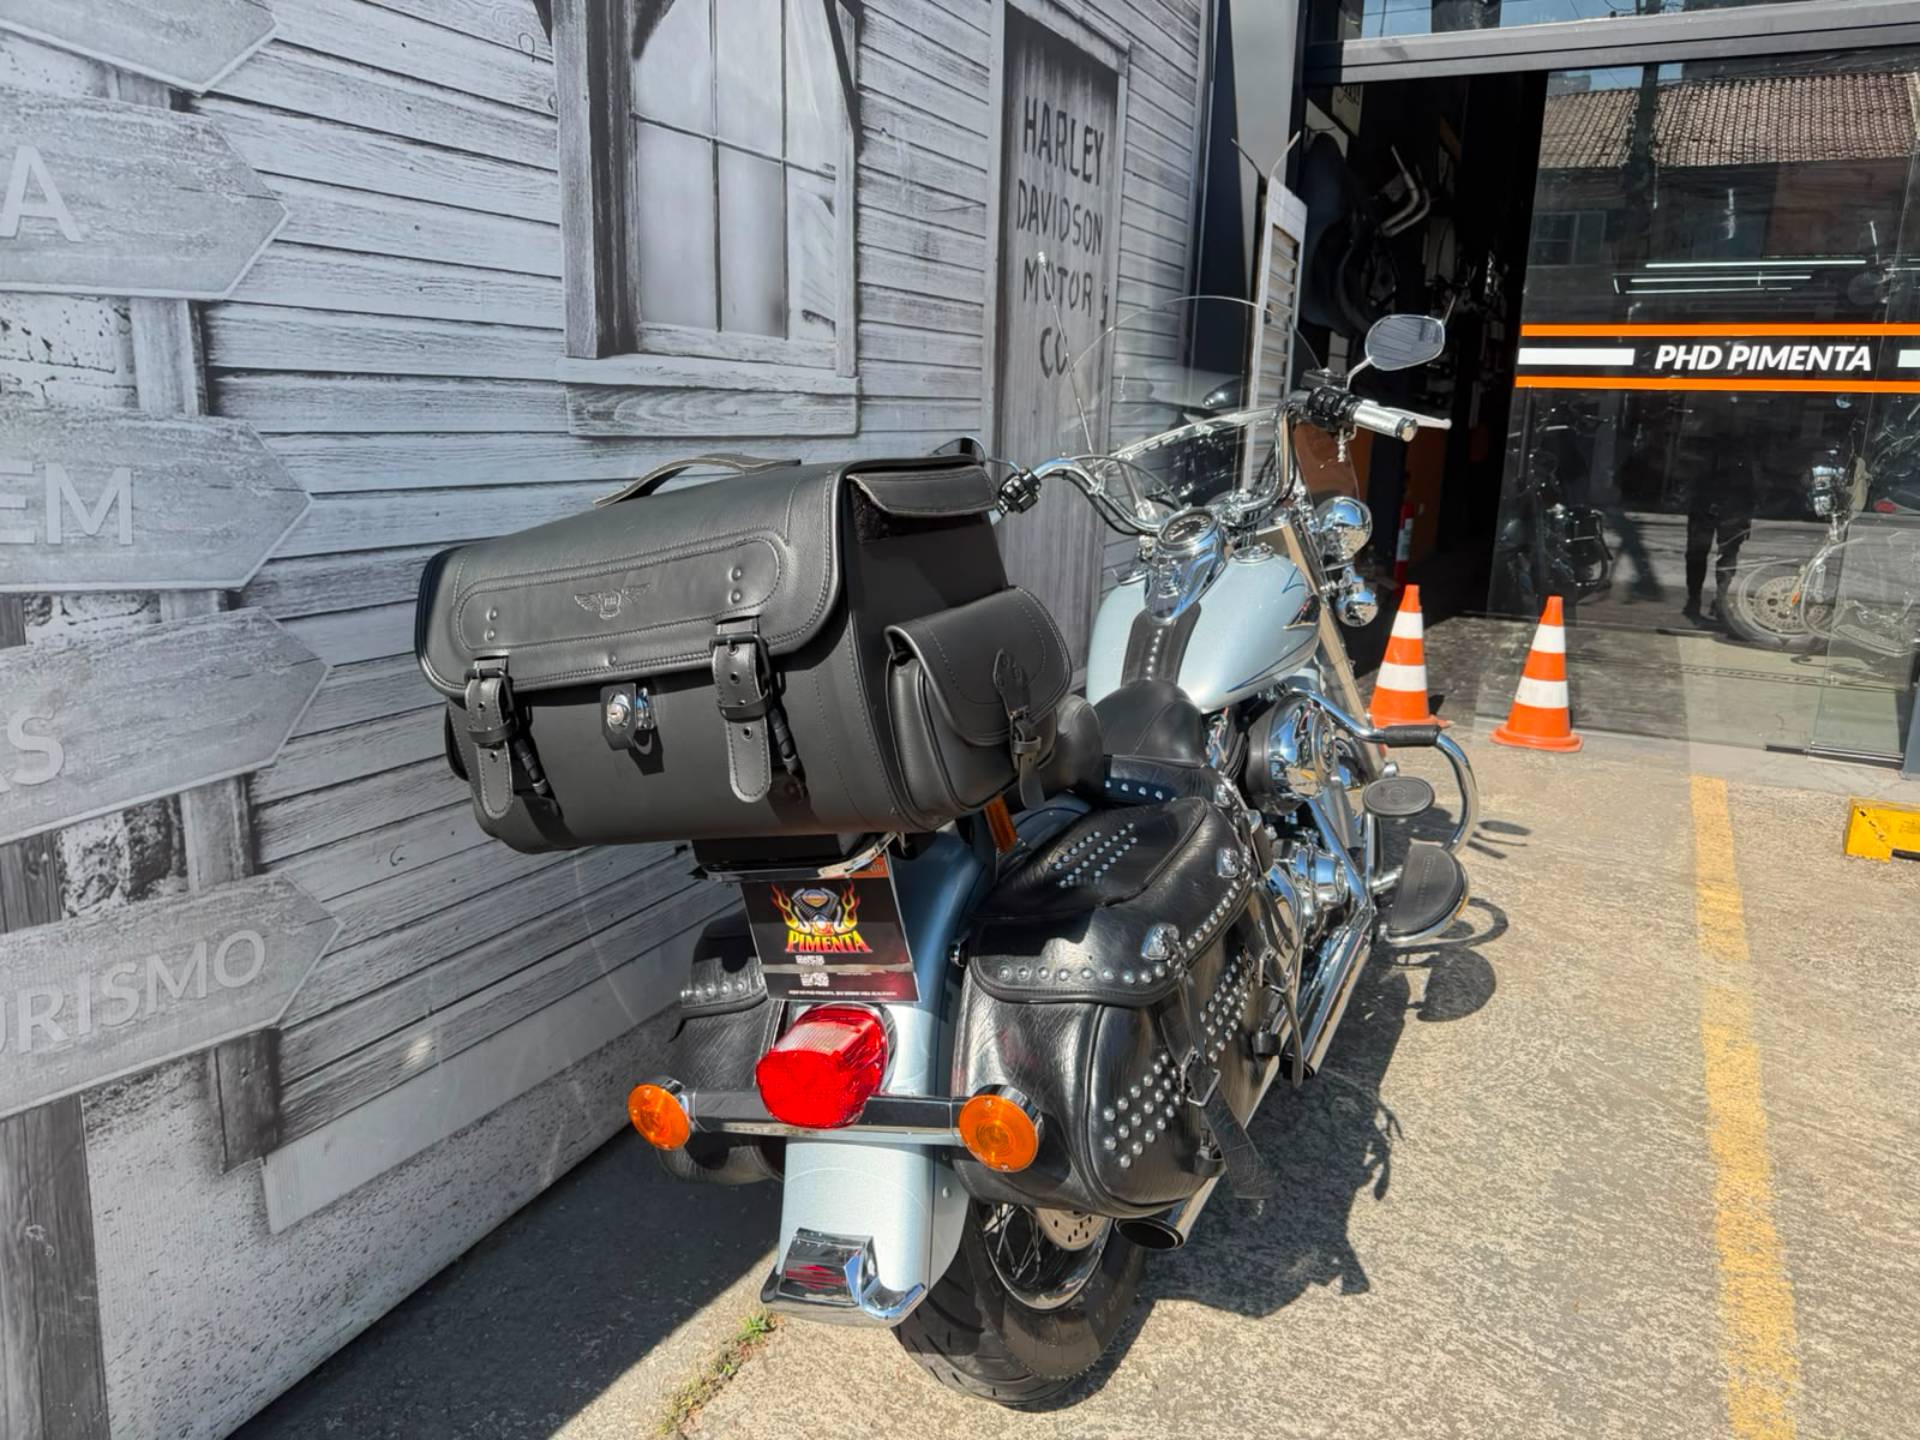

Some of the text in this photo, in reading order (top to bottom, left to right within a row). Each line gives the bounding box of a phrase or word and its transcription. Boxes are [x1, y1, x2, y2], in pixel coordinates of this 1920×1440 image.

[1022, 96, 1104, 186] HARLEY
[1016, 179, 1103, 256] DAVIDSON
[1023, 257, 1094, 318] MOTOR
[1040, 327, 1068, 378] CO
[1654, 345, 1872, 372] PHD PIMENTA
[786, 930, 873, 953] PIMENTA
[0, 929, 267, 1055] RISMO
